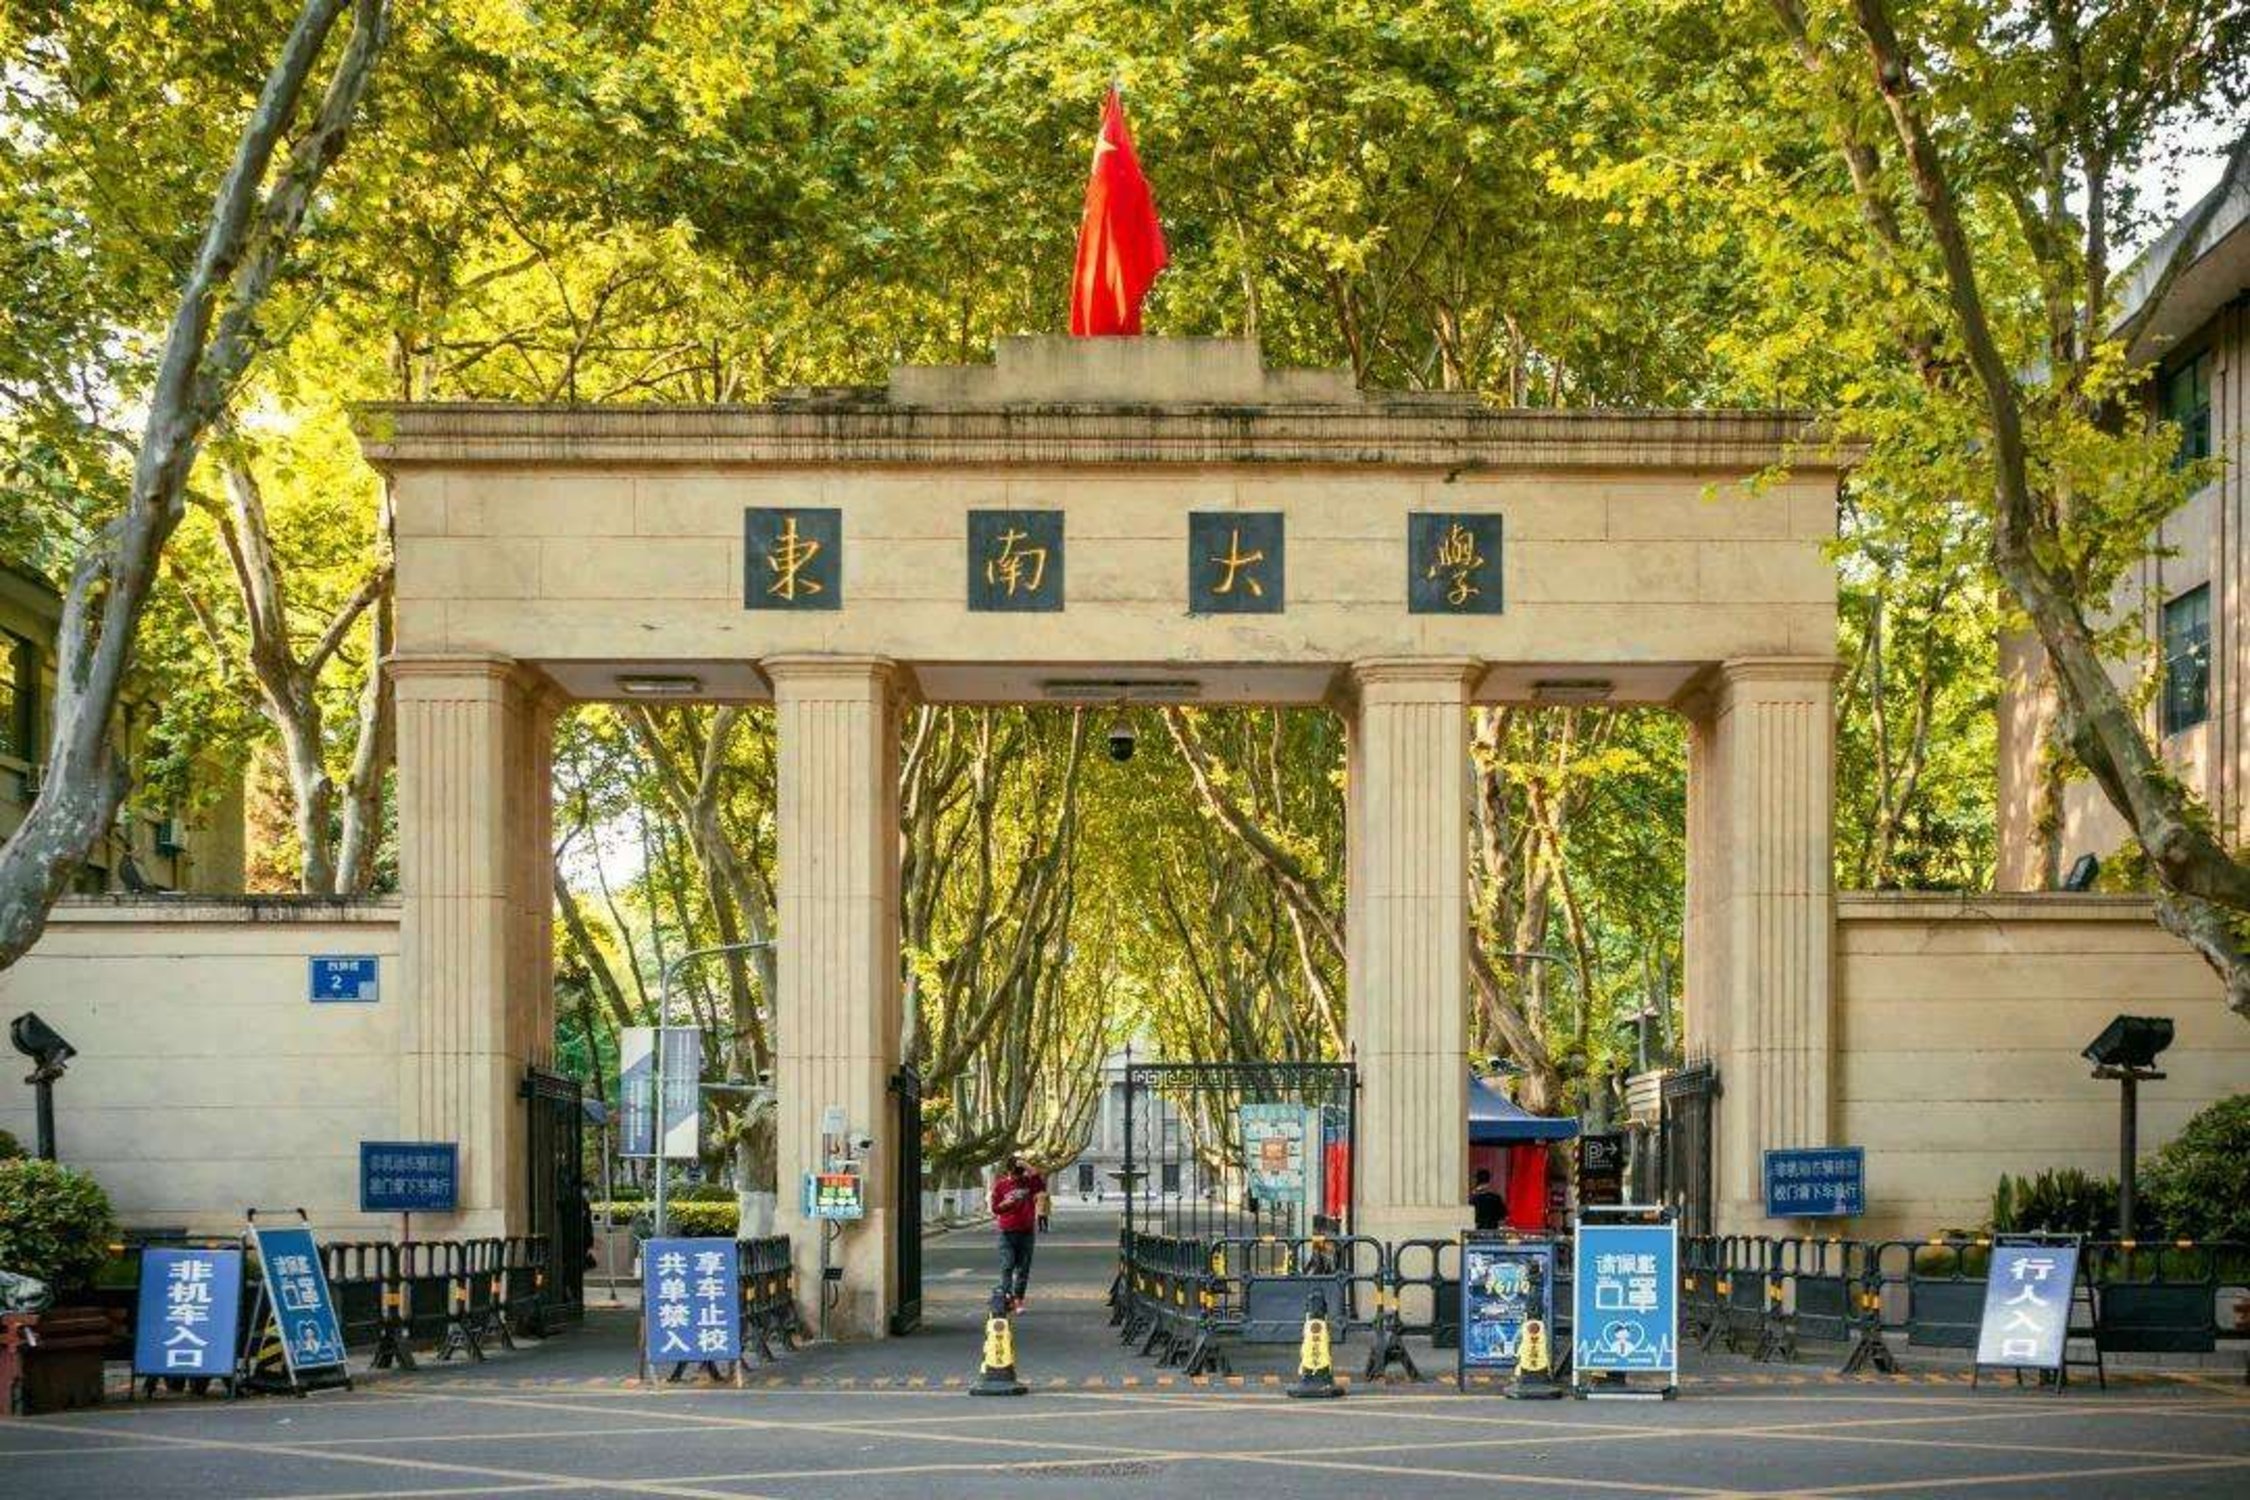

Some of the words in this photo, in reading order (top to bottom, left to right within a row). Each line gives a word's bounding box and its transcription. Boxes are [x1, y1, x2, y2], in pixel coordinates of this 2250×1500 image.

[331, 974, 342, 990] 2
[162, 1259, 213, 1368] 非机车入口
[2001, 1258, 2055, 1357] 行人入口
